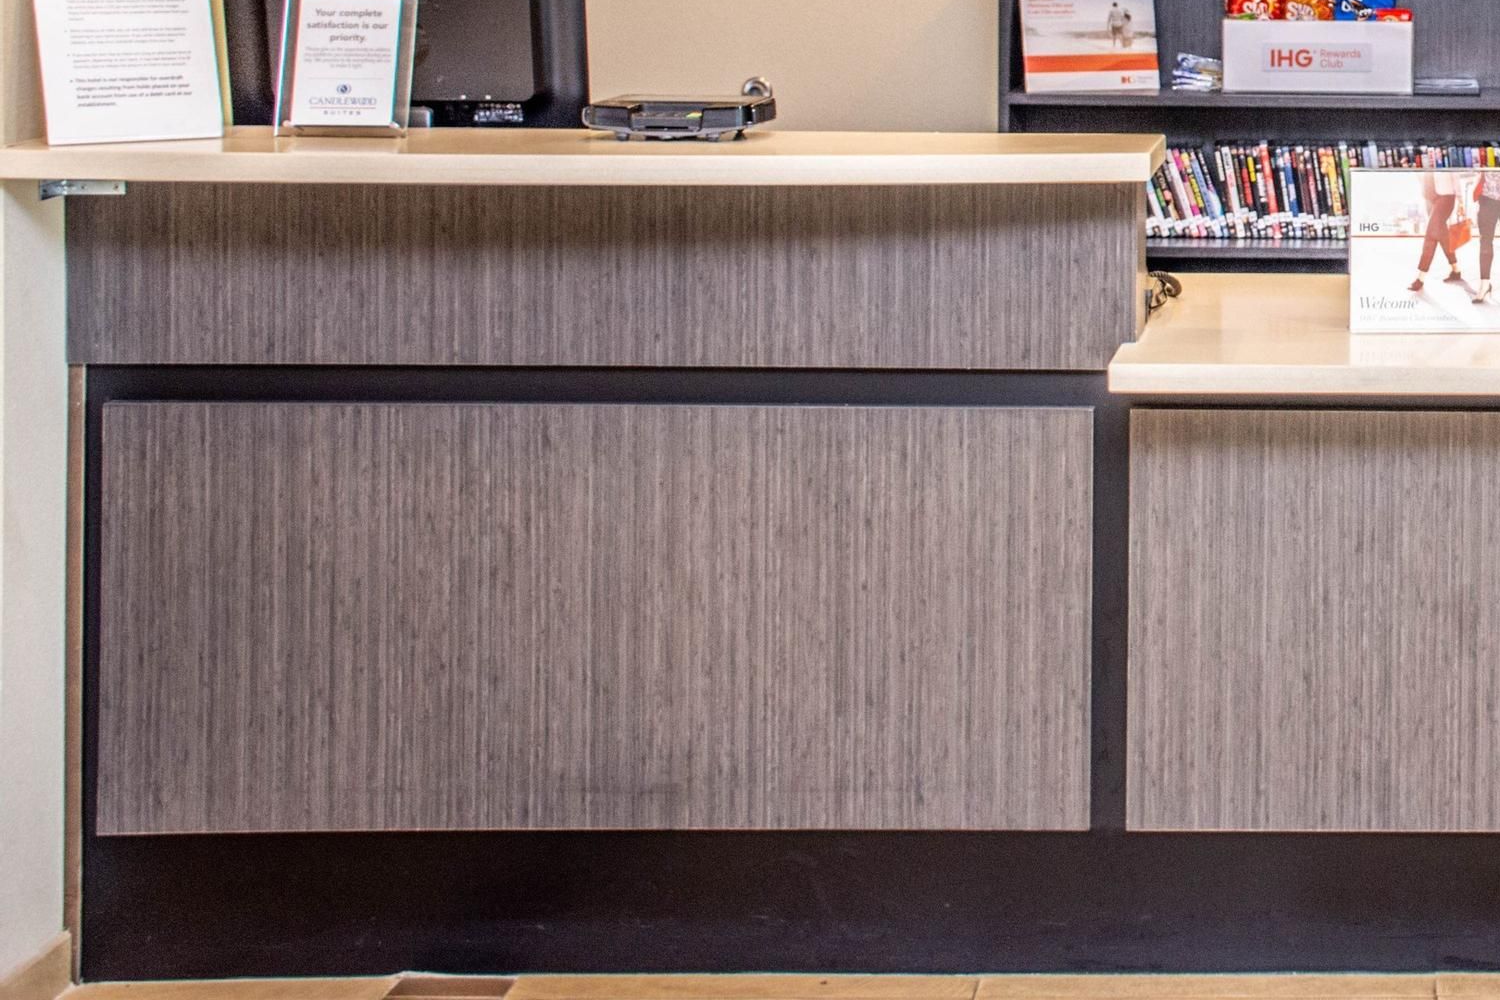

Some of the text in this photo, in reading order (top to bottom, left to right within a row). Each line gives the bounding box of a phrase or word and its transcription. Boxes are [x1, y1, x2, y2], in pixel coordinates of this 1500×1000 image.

[315, 8, 383, 19] Your complete
[307, 21, 388, 30] satisfaction is our
[329, 34, 367, 44] priority.
[1270, 49, 1362, 68] IHG Rewards
[1319, 59, 1344, 69] Club
[309, 96, 377, 105] CANDLEWOOD
[1359, 223, 1380, 232] IHG
[1359, 296, 1418, 310] Welcome
